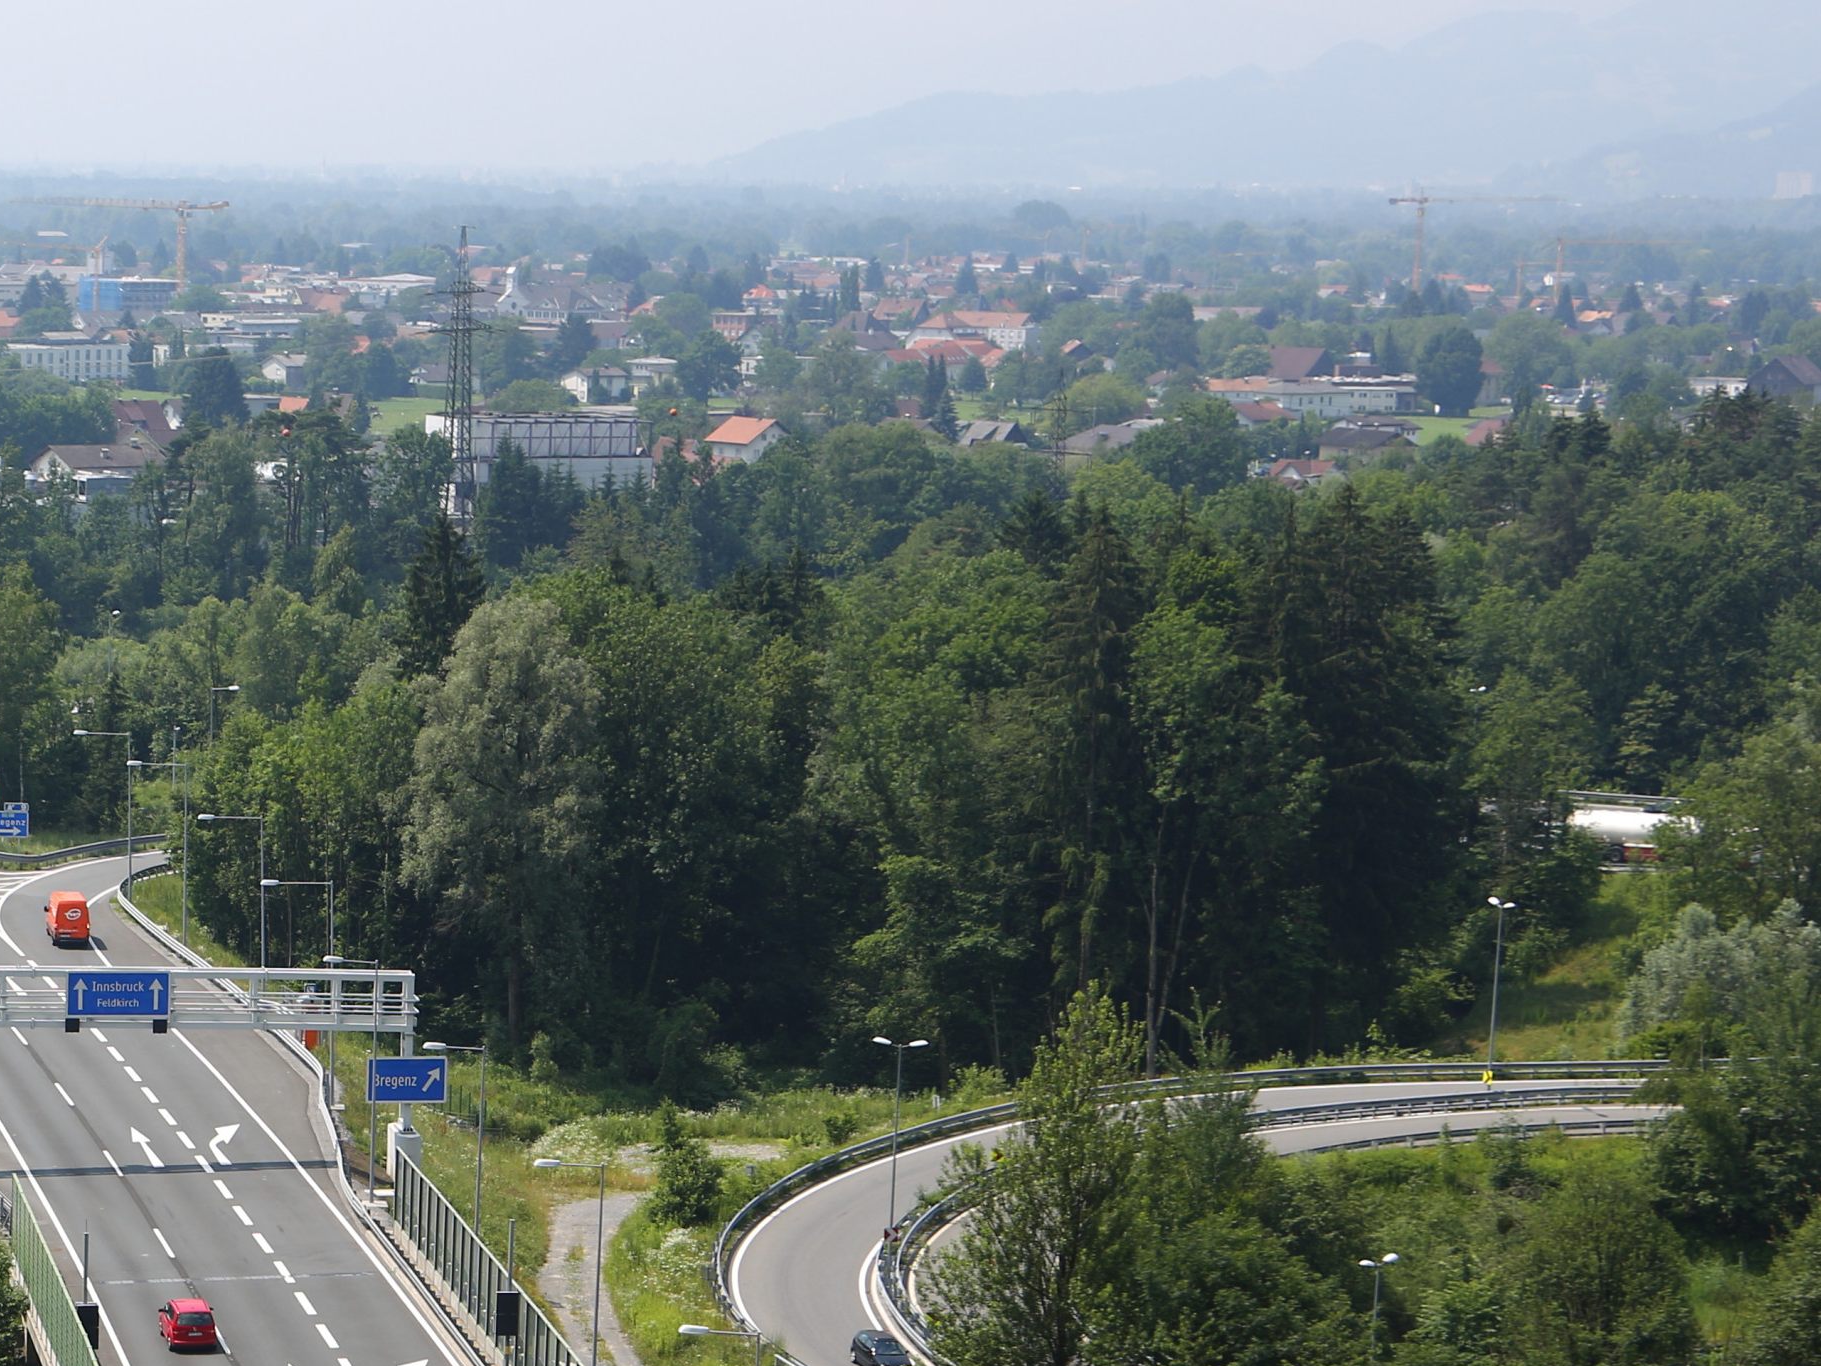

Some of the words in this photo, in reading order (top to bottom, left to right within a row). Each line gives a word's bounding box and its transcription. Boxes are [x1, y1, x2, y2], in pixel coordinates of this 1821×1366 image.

[92, 981, 144, 992] Innsbruck
[97, 998, 139, 1007] Feldkirch
[374, 1073, 417, 1090] Bregenz
